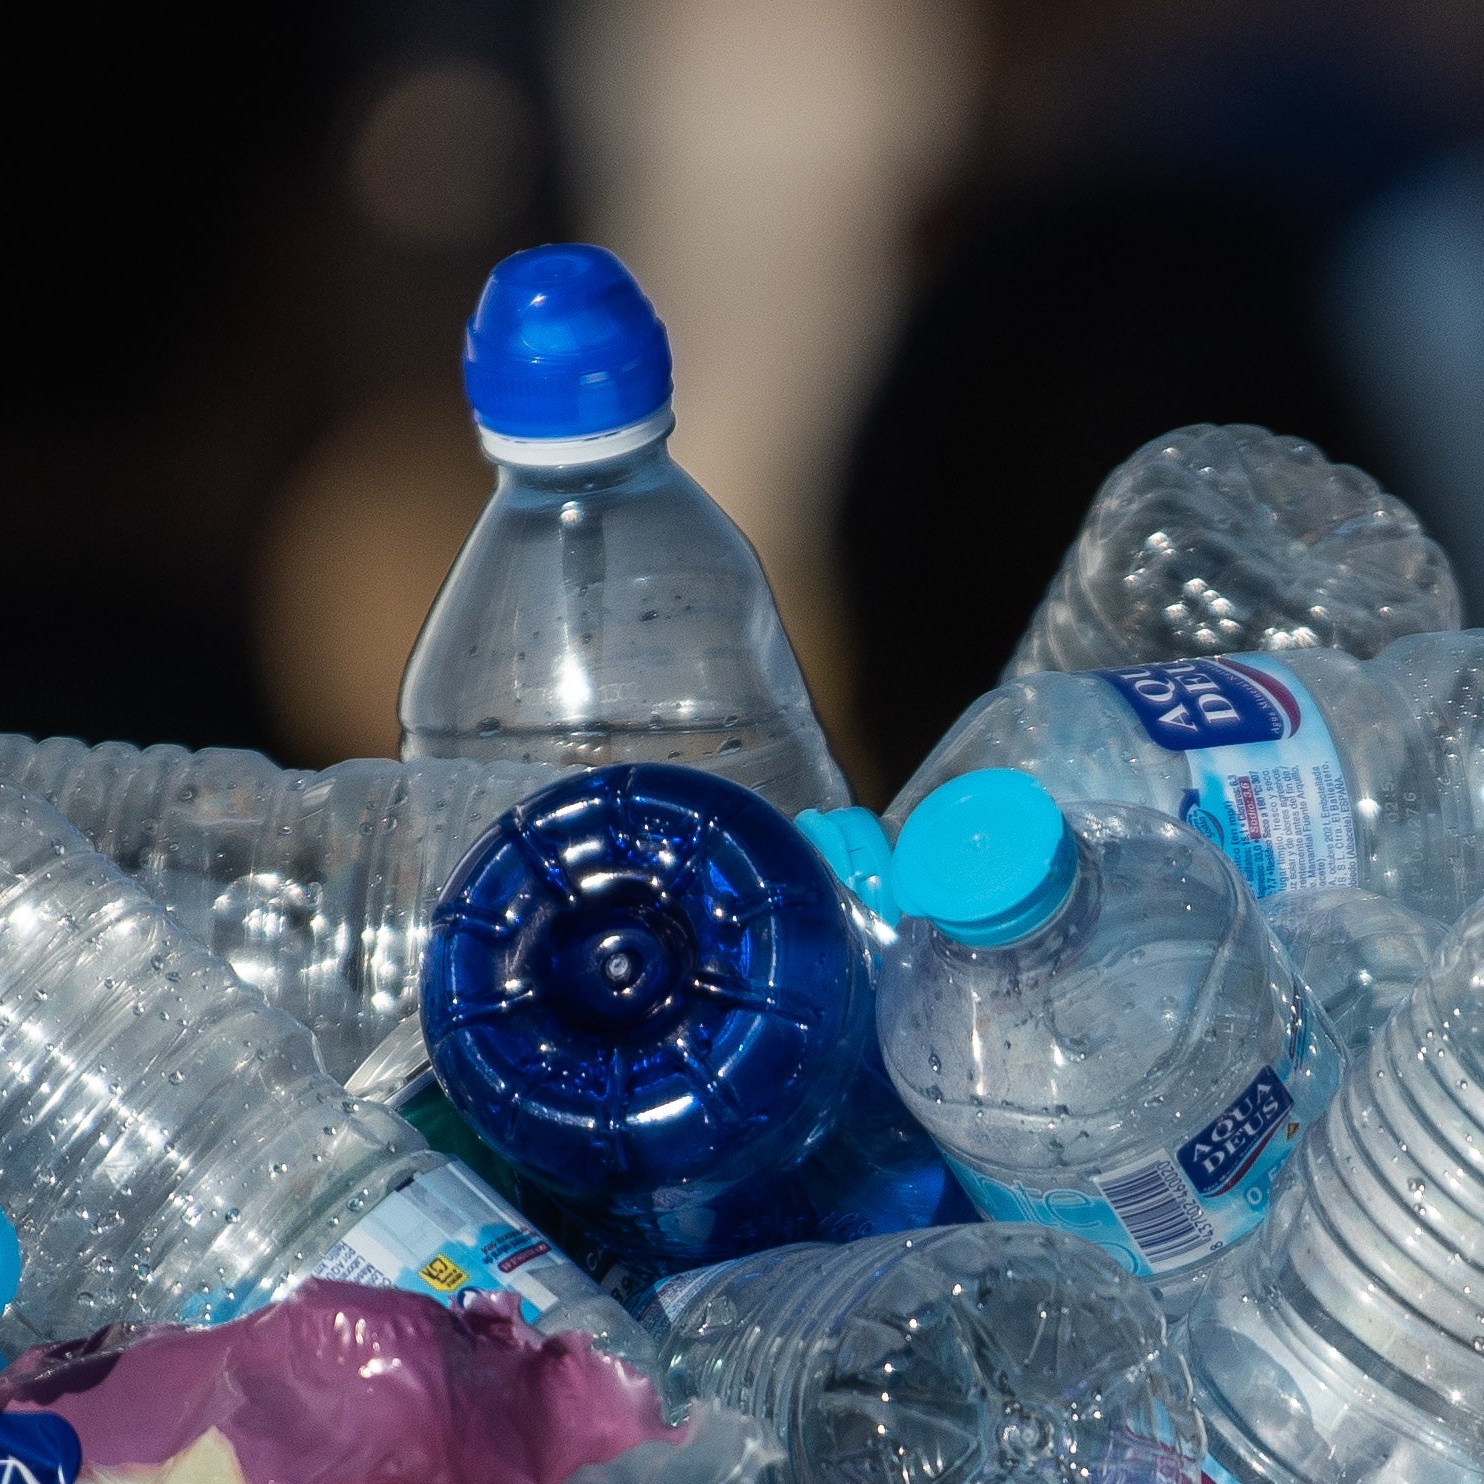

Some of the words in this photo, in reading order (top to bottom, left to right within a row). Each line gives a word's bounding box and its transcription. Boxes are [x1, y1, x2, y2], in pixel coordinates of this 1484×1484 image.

[1120, 665, 1202, 732] AQU
[1164, 660, 1243, 727] DEU
[1240, 781, 1251, 798] 3,6
[1284, 782, 1294, 793] fin
[1244, 799, 1259, 834] Sodio:
[1266, 801, 1281, 831] fresco
[1298, 800, 1311, 831] Fuente
[1283, 837, 1294, 849] de
[1302, 833, 1317, 877] Manantial
[1293, 837, 1308, 888] rentemente
[1182, 1077, 1278, 1163] AQUA
[1196, 1094, 1285, 1174] DEUS
[1208, 1239, 1224, 1251] 8
